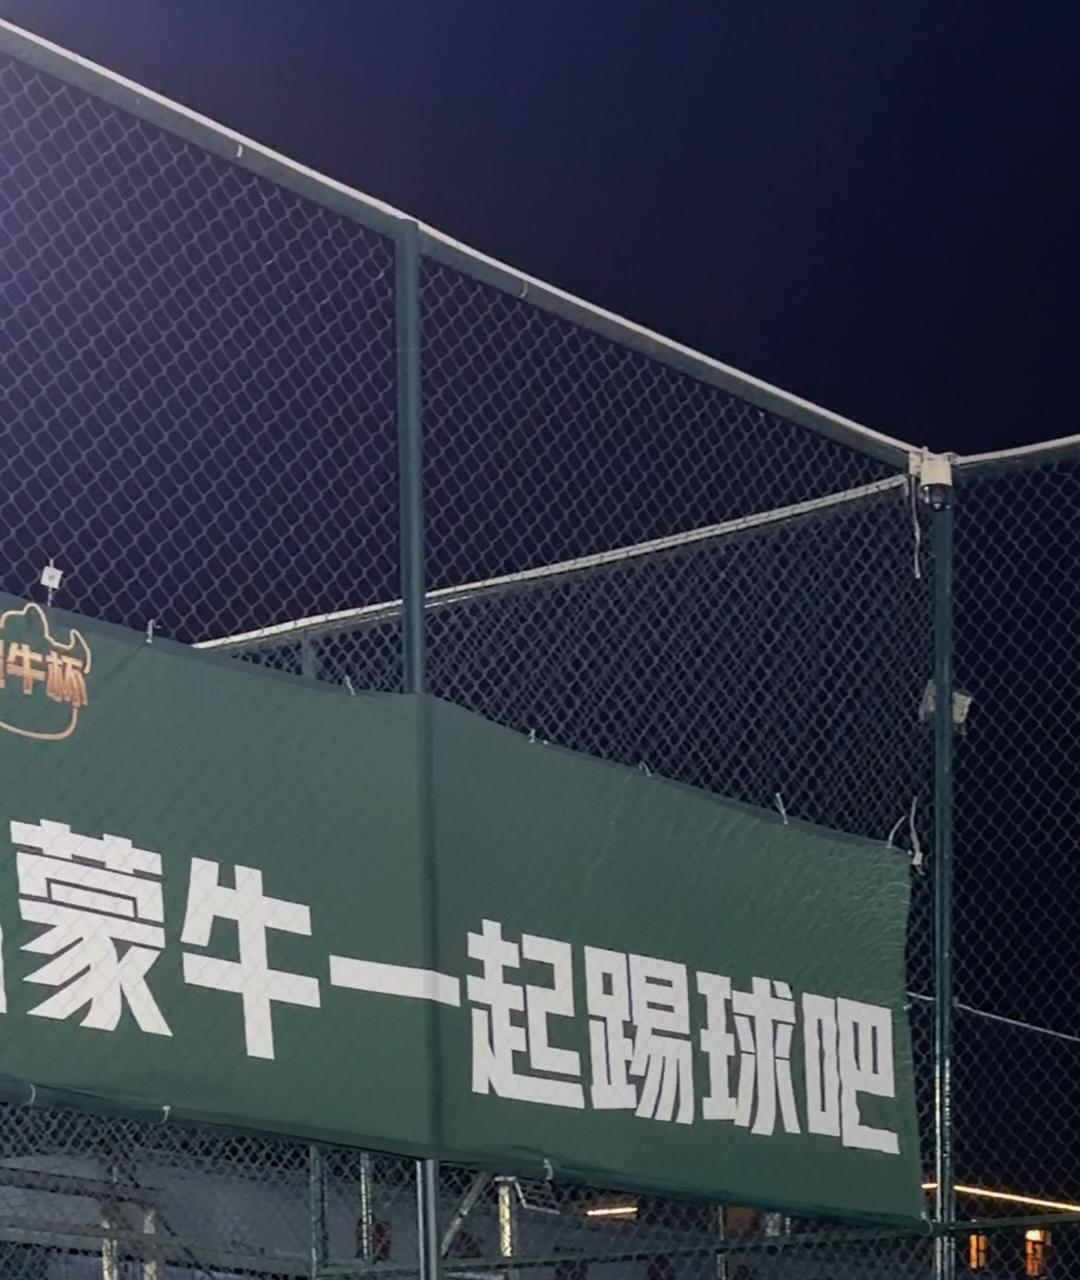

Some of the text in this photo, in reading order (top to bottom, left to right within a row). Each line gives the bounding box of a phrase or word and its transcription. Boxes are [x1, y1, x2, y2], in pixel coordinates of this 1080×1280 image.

[0, 640, 88, 707] 牛杯
[0, 819, 900, 1154] 蒙牛一起踢球吧
